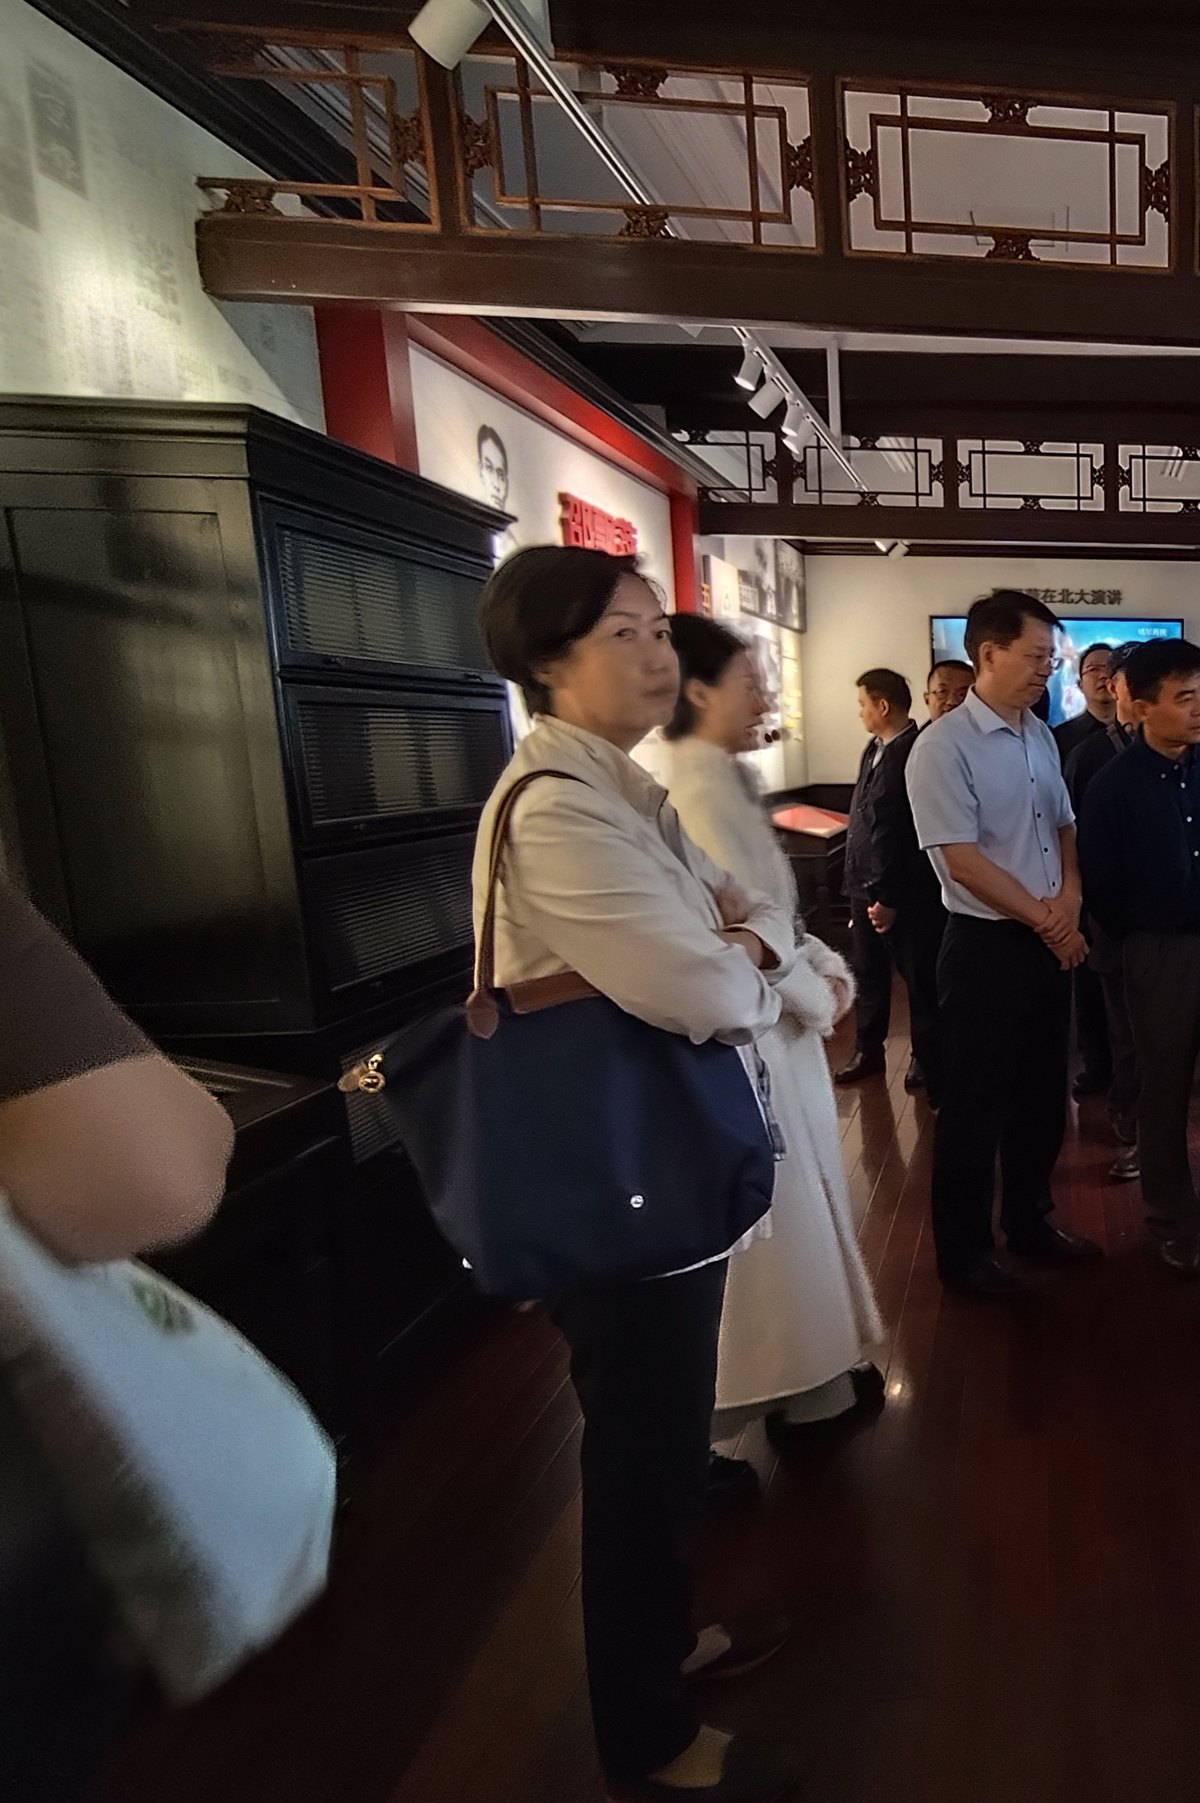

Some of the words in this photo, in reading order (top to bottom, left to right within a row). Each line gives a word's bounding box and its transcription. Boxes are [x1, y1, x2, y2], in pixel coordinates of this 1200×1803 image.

[992, 588, 1122, 605] 在北大演讲
